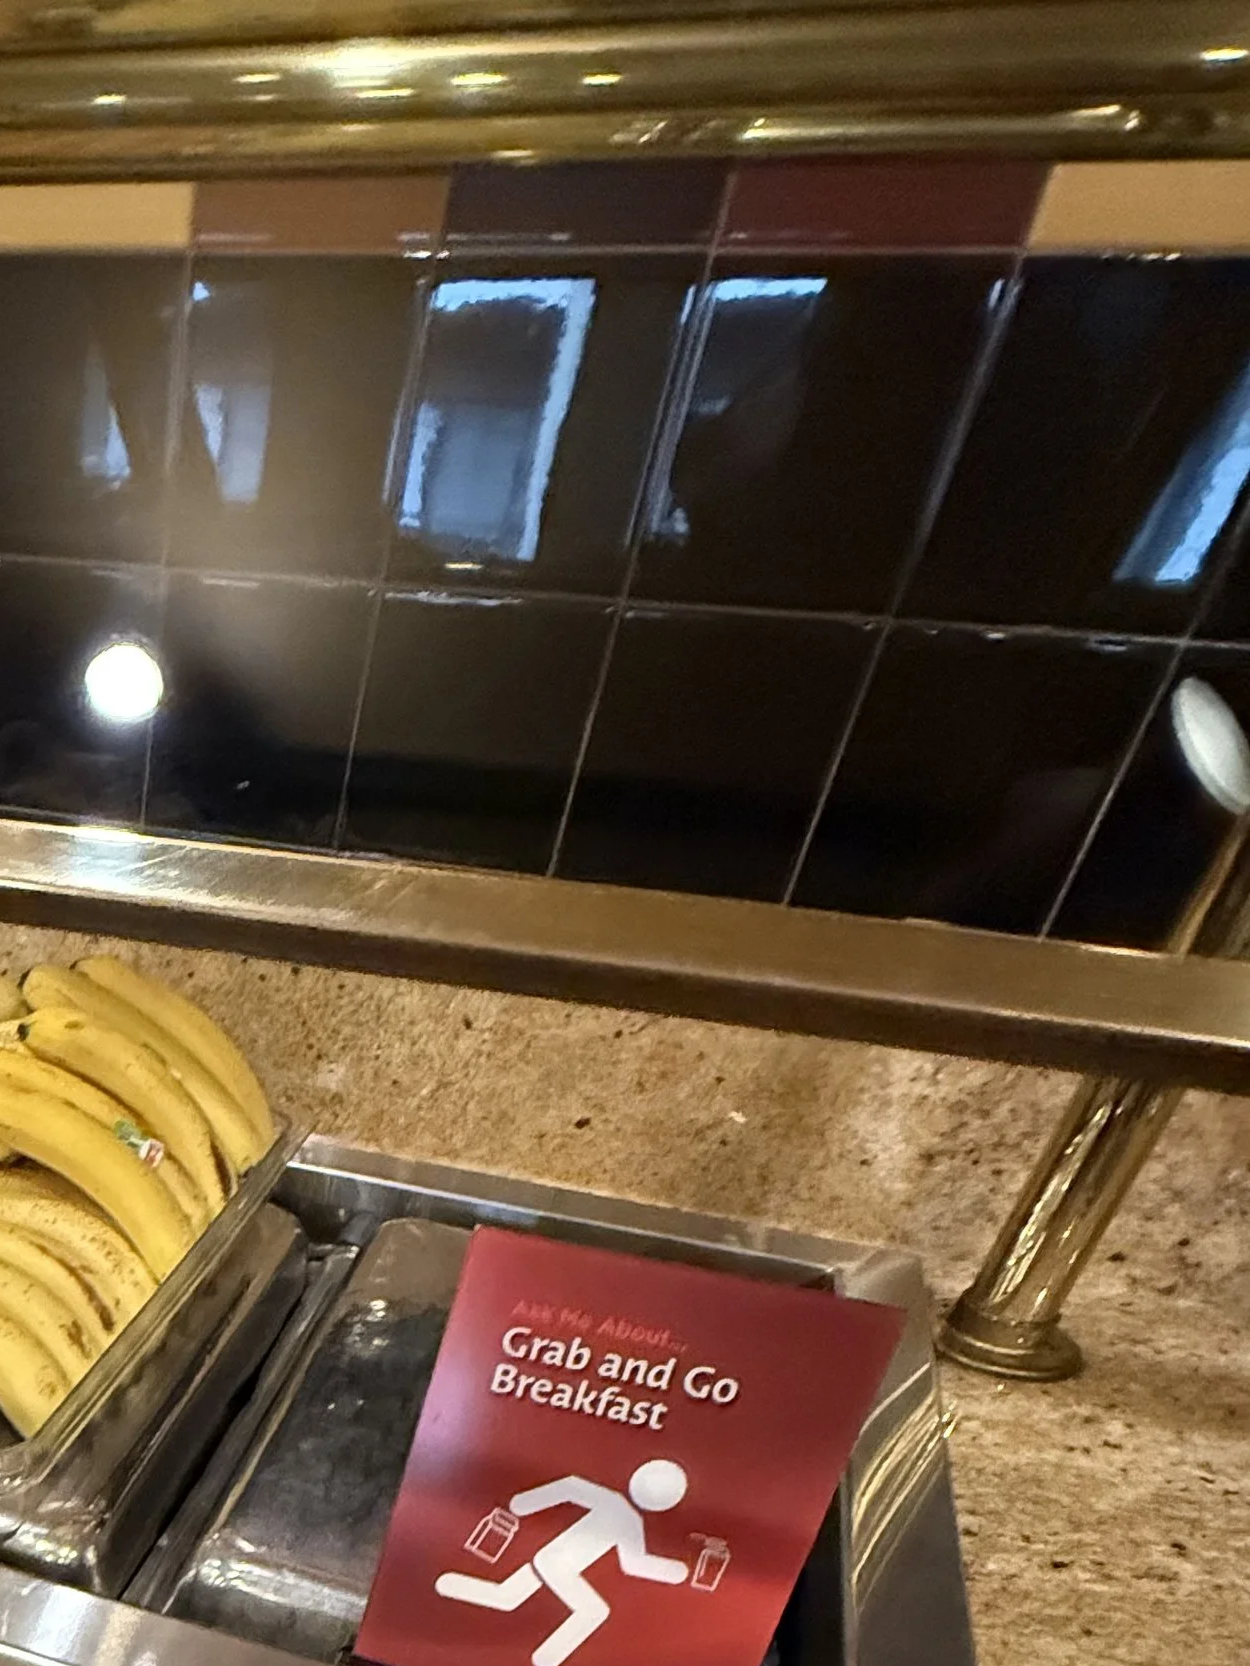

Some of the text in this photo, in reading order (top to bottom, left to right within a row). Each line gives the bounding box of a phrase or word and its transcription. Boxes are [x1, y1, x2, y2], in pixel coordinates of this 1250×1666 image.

[490, 1363, 669, 1431] Breakfast
[501, 1326, 740, 1404] Grab and Go
